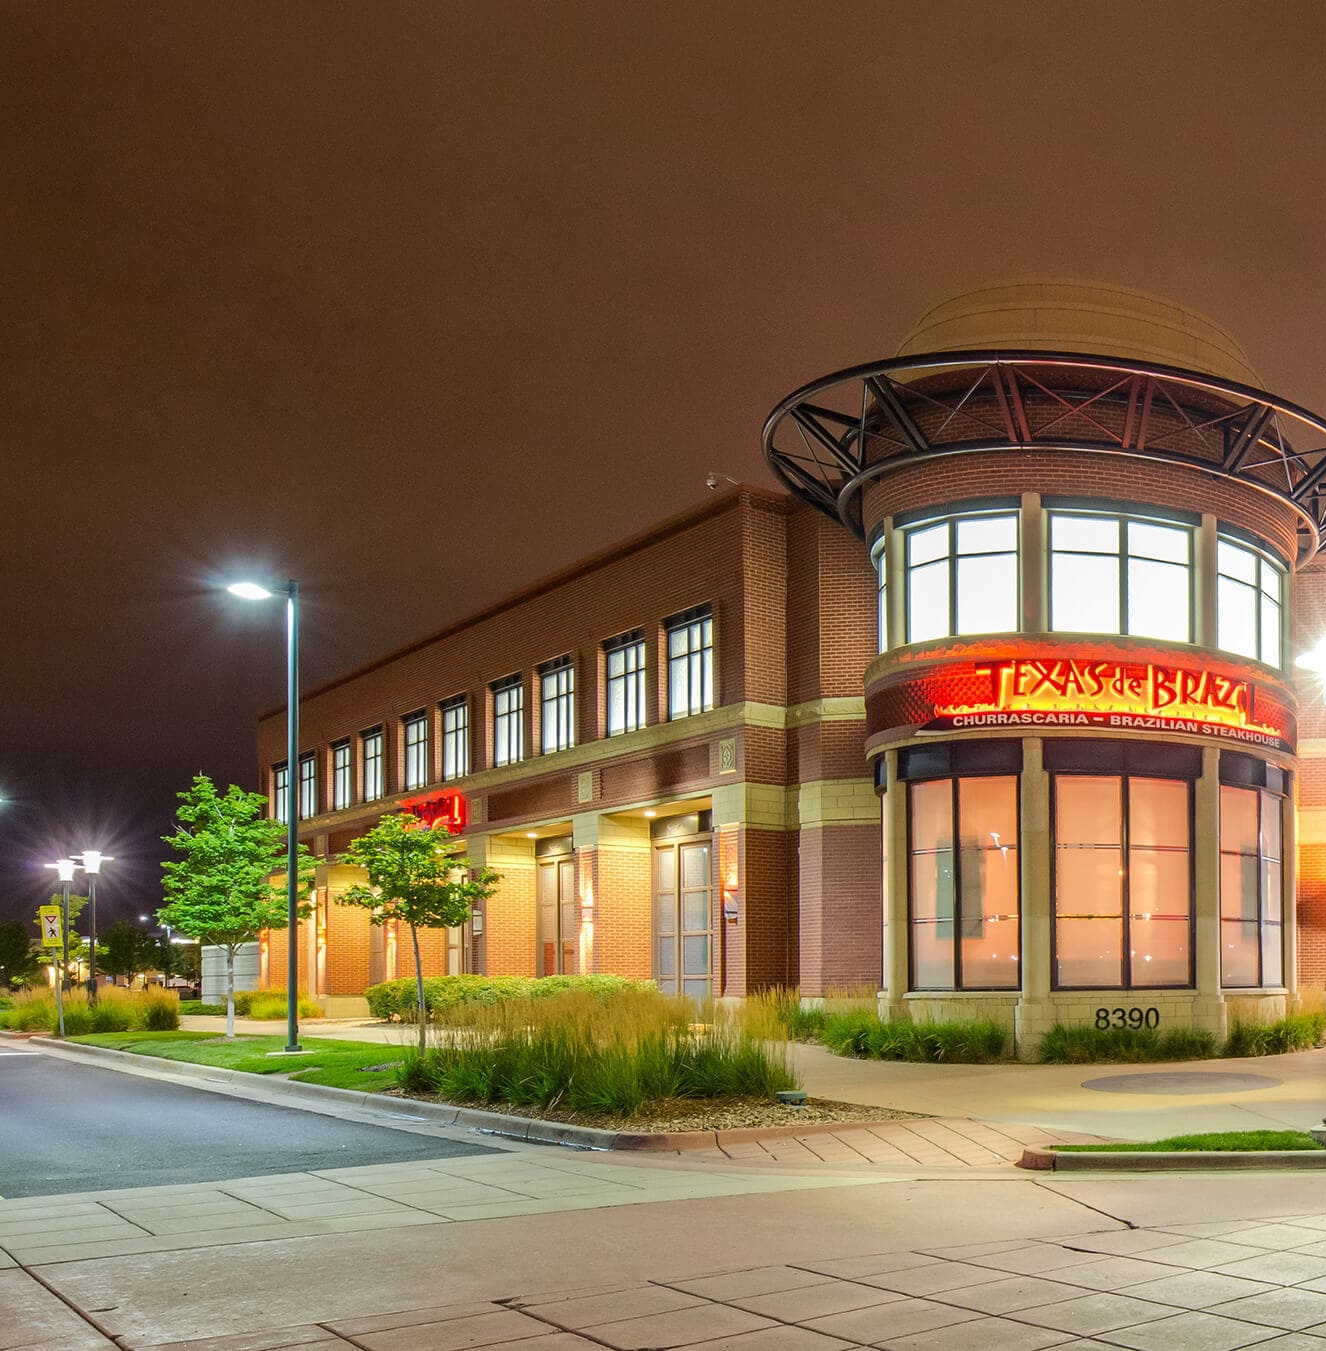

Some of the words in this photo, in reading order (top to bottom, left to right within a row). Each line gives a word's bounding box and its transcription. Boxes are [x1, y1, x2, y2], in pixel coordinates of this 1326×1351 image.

[976, 660, 1107, 710] TEXAS
[953, 713, 1089, 727] CHURRASCARIA
[1110, 714, 1198, 733] BRAZILIAN
[1202, 723, 1280, 748] STEAKHOUSE
[1095, 1007, 1160, 1030] 8390
